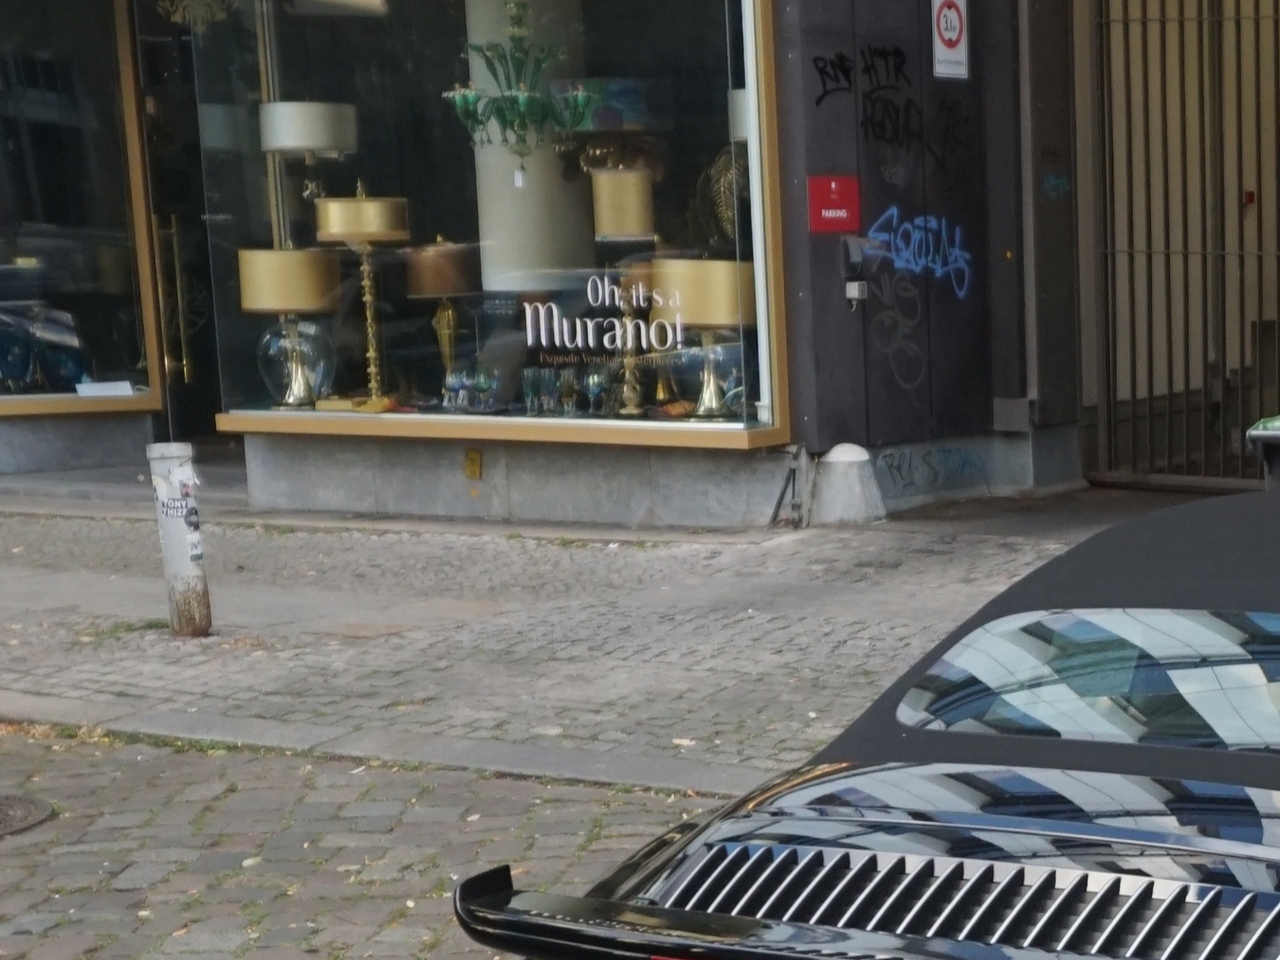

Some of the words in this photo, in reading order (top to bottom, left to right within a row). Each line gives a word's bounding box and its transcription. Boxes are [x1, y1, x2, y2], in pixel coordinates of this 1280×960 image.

[822, 209, 847, 218] PARKING
[631, 282, 663, 307] its
[669, 289, 680, 307] a
[523, 302, 682, 350] Murano!
[540, 352, 580, 367] Exquisite
[163, 499, 187, 508] TONY
